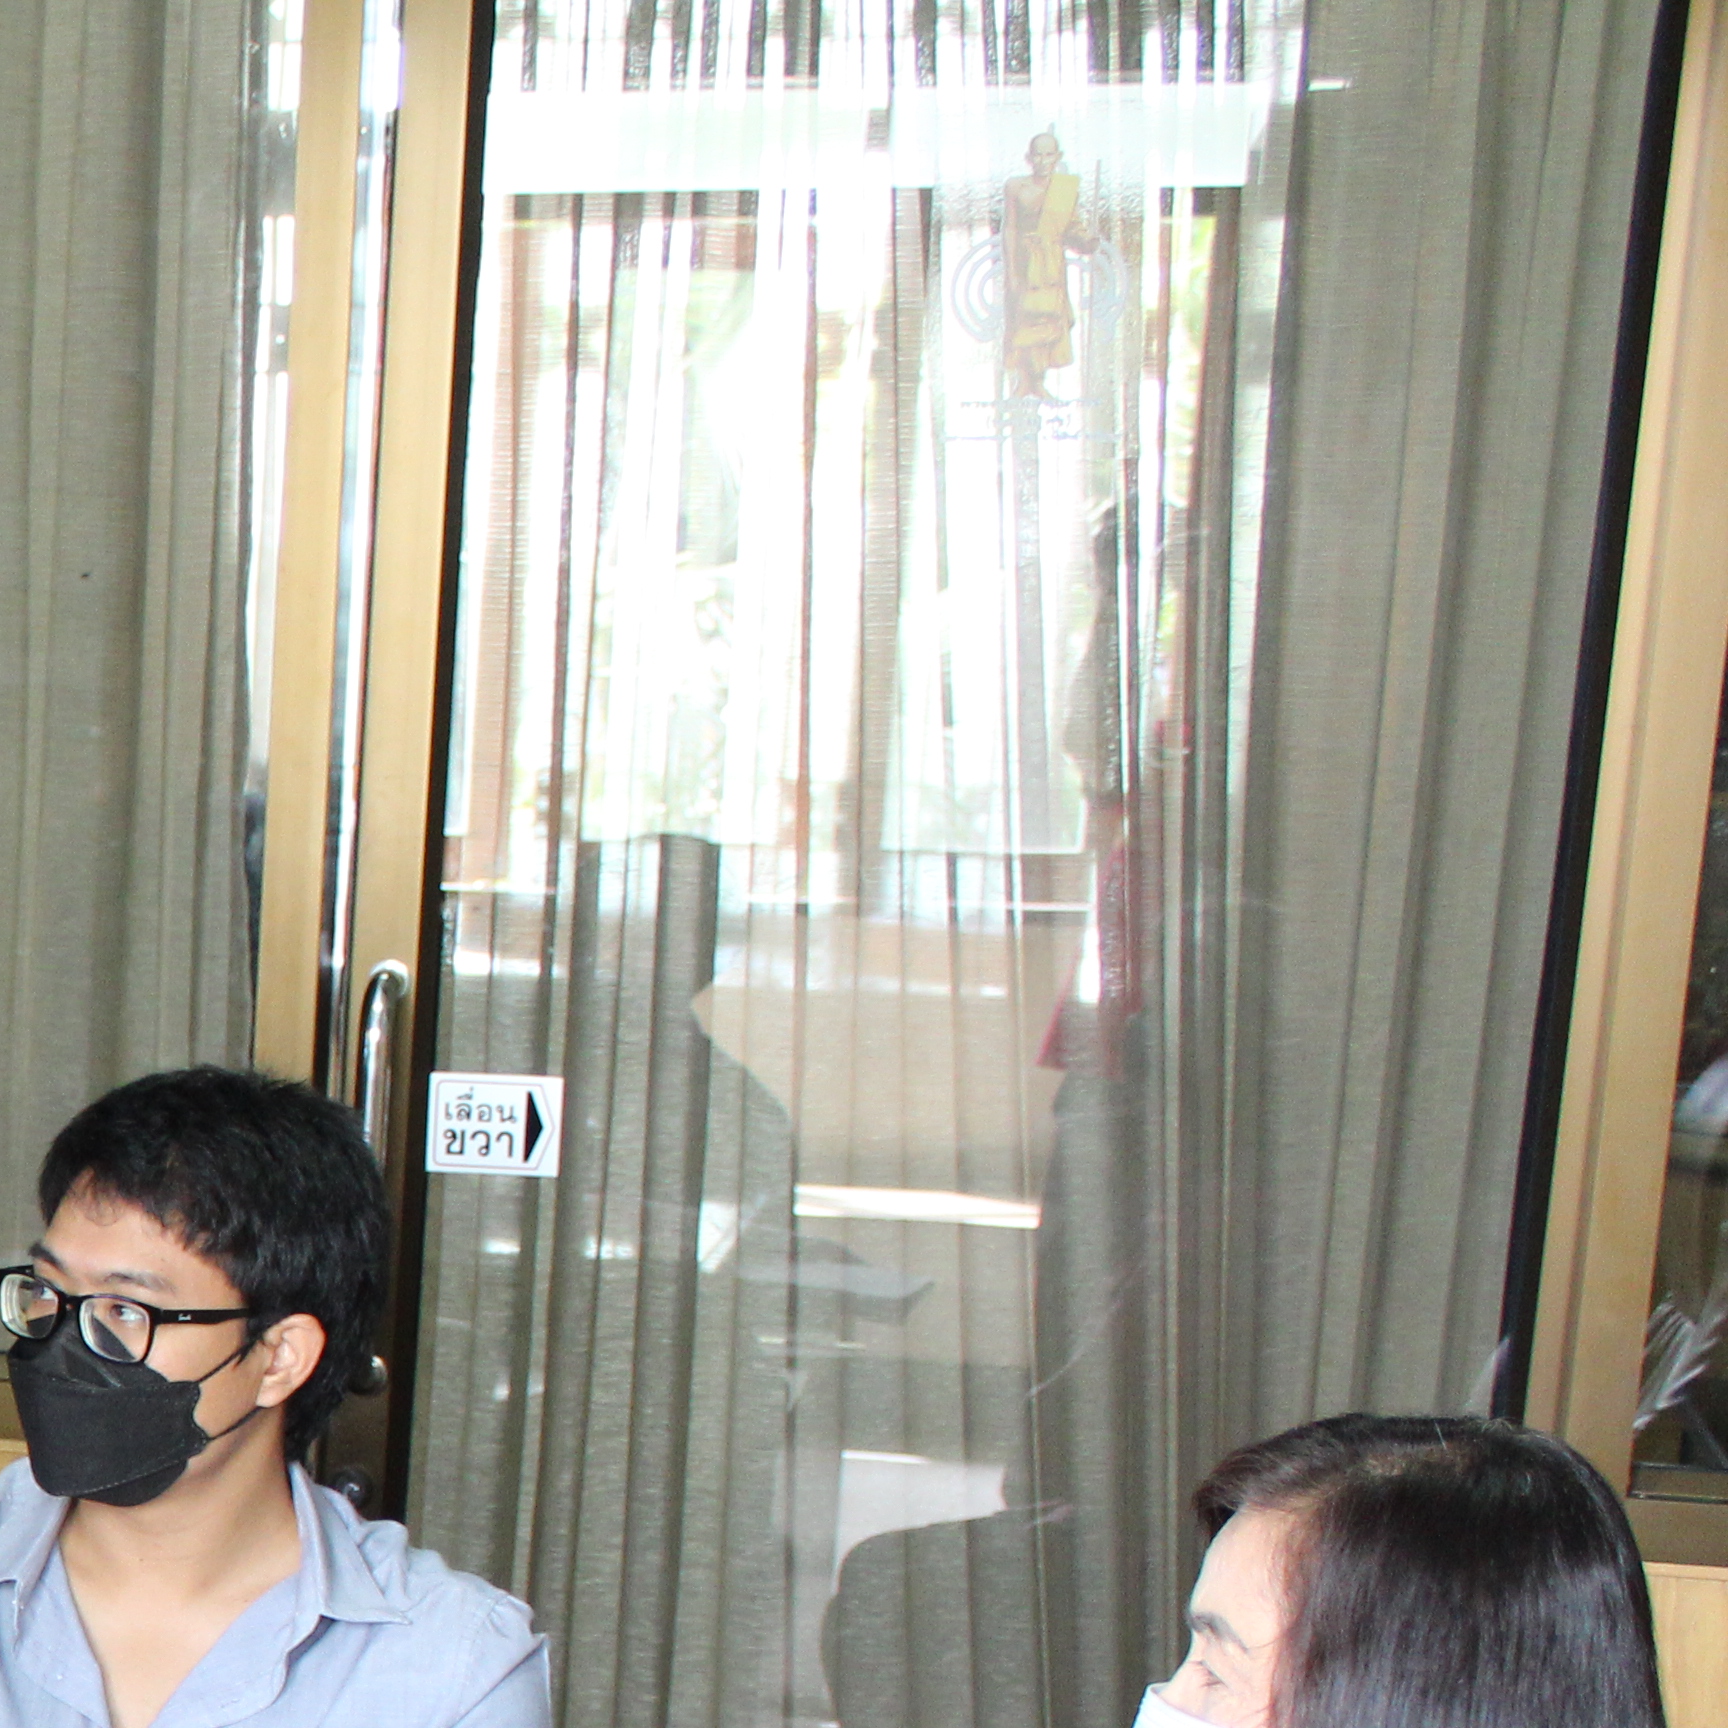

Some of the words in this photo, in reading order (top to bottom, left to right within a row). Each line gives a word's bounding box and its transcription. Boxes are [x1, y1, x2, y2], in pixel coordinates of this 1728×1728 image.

[443, 1085, 518, 1124] เลื่อน
[442, 1128, 515, 1159] ขวา
